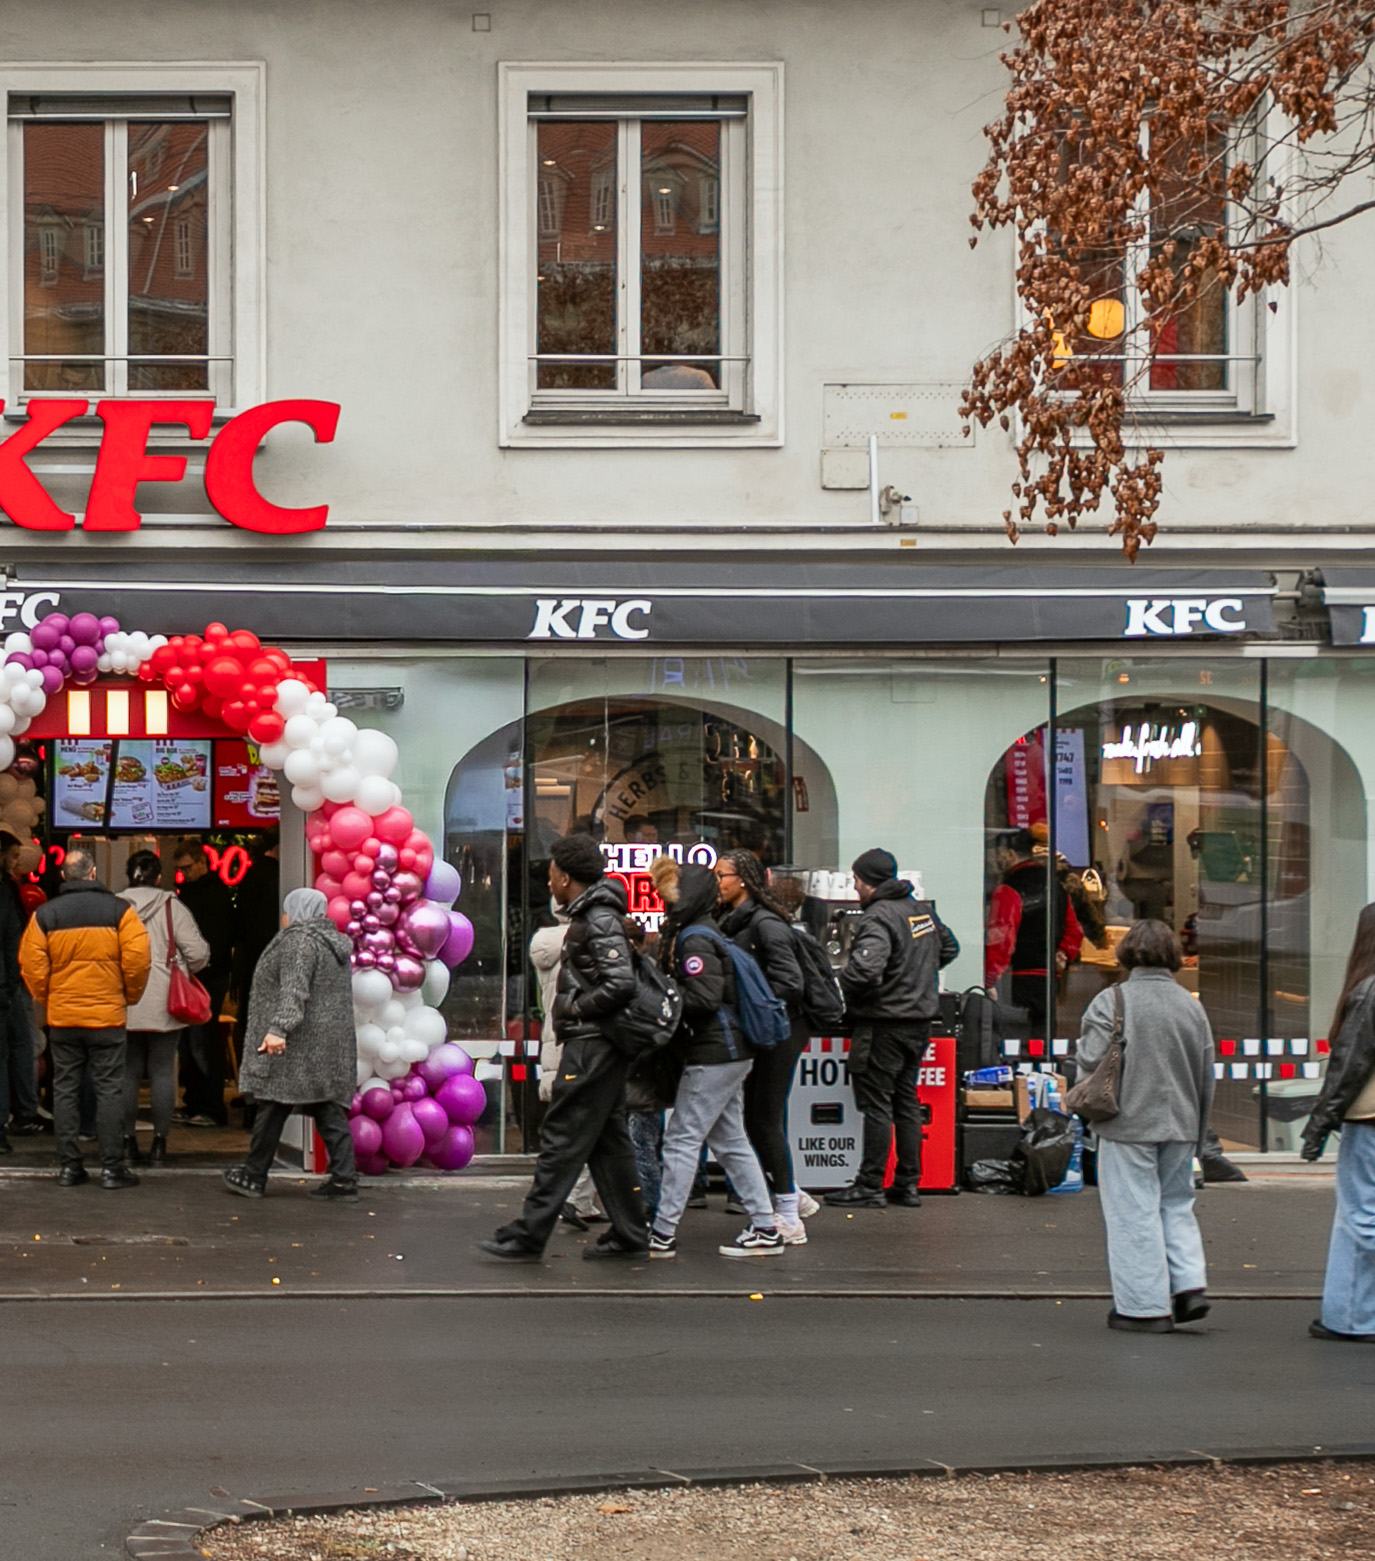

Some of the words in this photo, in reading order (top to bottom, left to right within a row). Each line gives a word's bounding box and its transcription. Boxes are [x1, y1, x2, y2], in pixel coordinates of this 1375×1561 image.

[527, 599, 652, 640] KFC
[1124, 598, 1246, 636] KFC
[800, 1058, 850, 1087] HOT
[799, 1137, 825, 1151] LIKE
[828, 1137, 855, 1151] OUR
[804, 1154, 850, 1167] WINGS.
